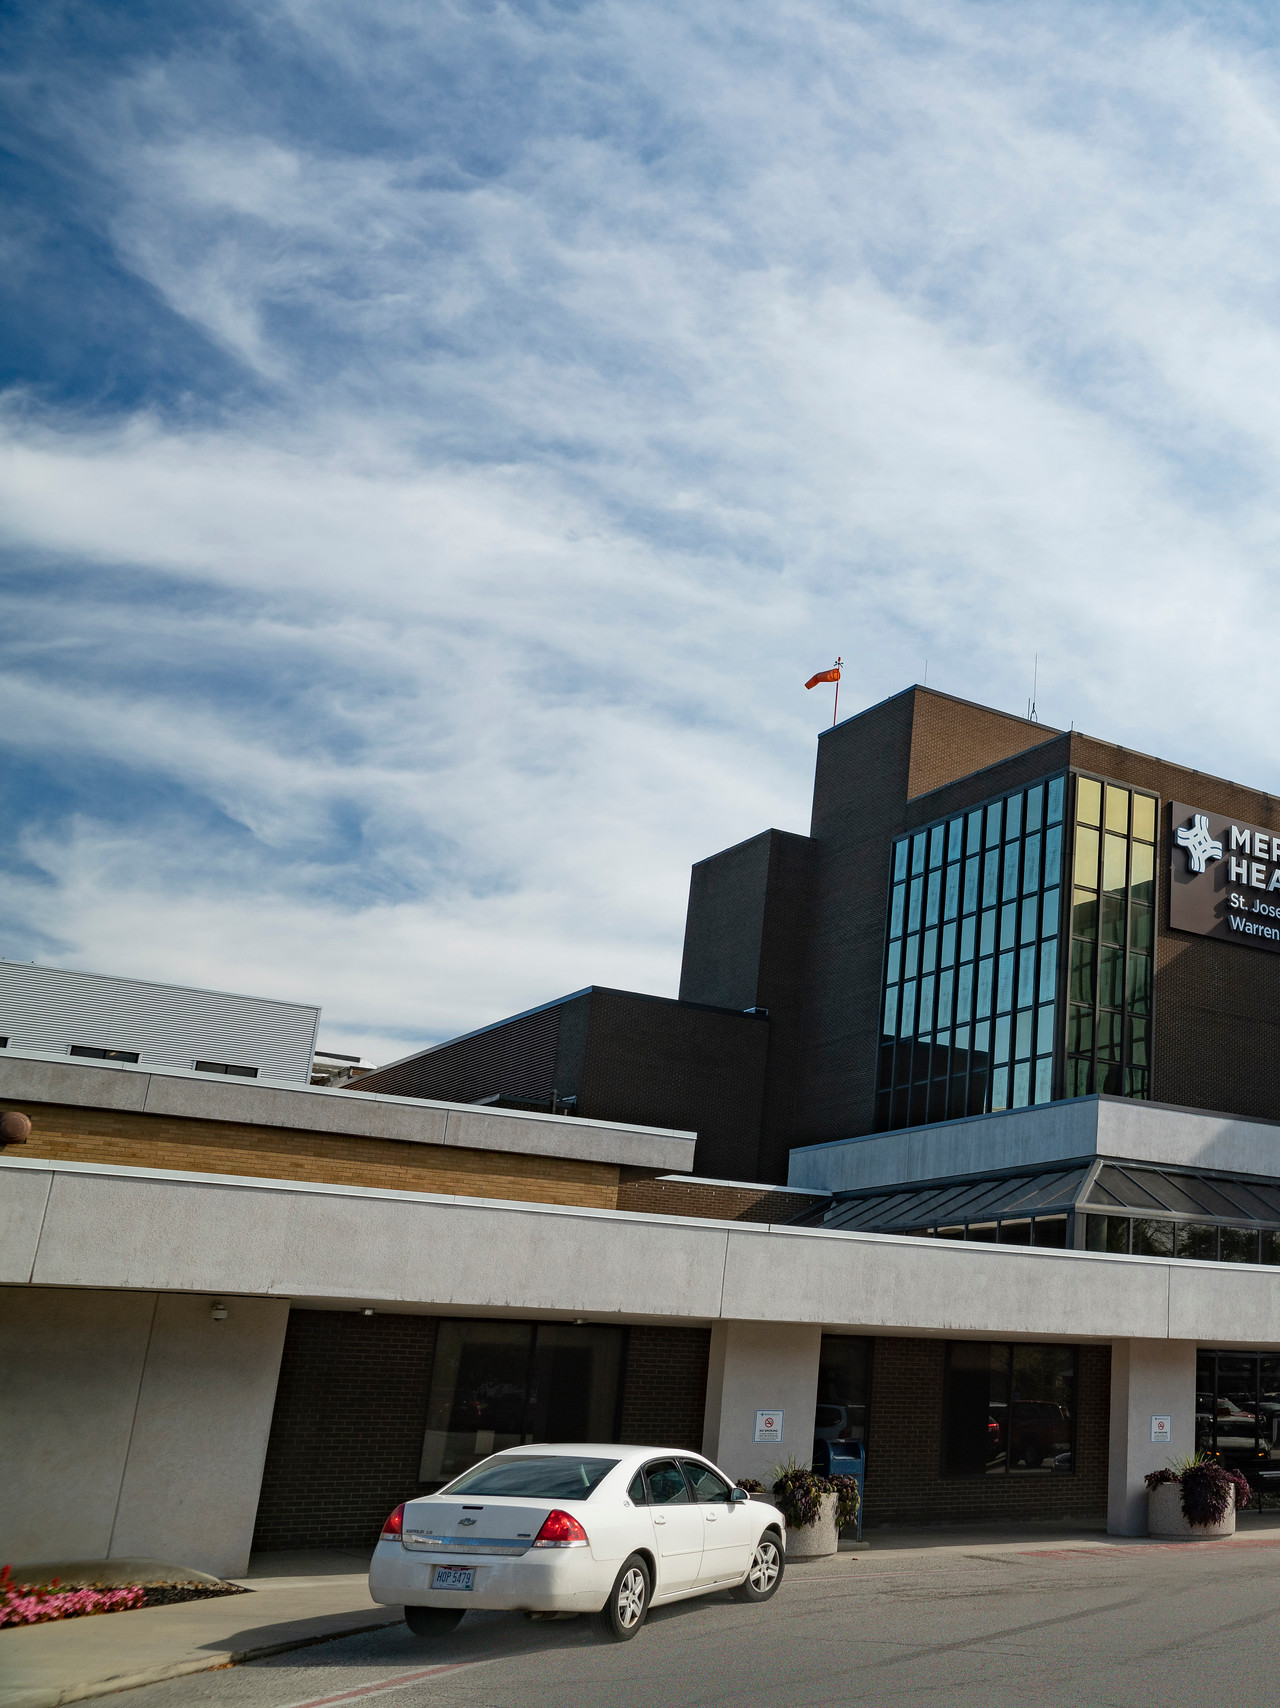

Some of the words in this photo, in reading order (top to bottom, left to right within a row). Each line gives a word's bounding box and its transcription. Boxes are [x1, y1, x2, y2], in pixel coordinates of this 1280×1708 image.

[1230, 893, 1248, 911] St.
[1229, 915, 1280, 941] Warren
[436, 1571, 451, 1583] HOP
[453, 1572, 471, 1584] 5479
